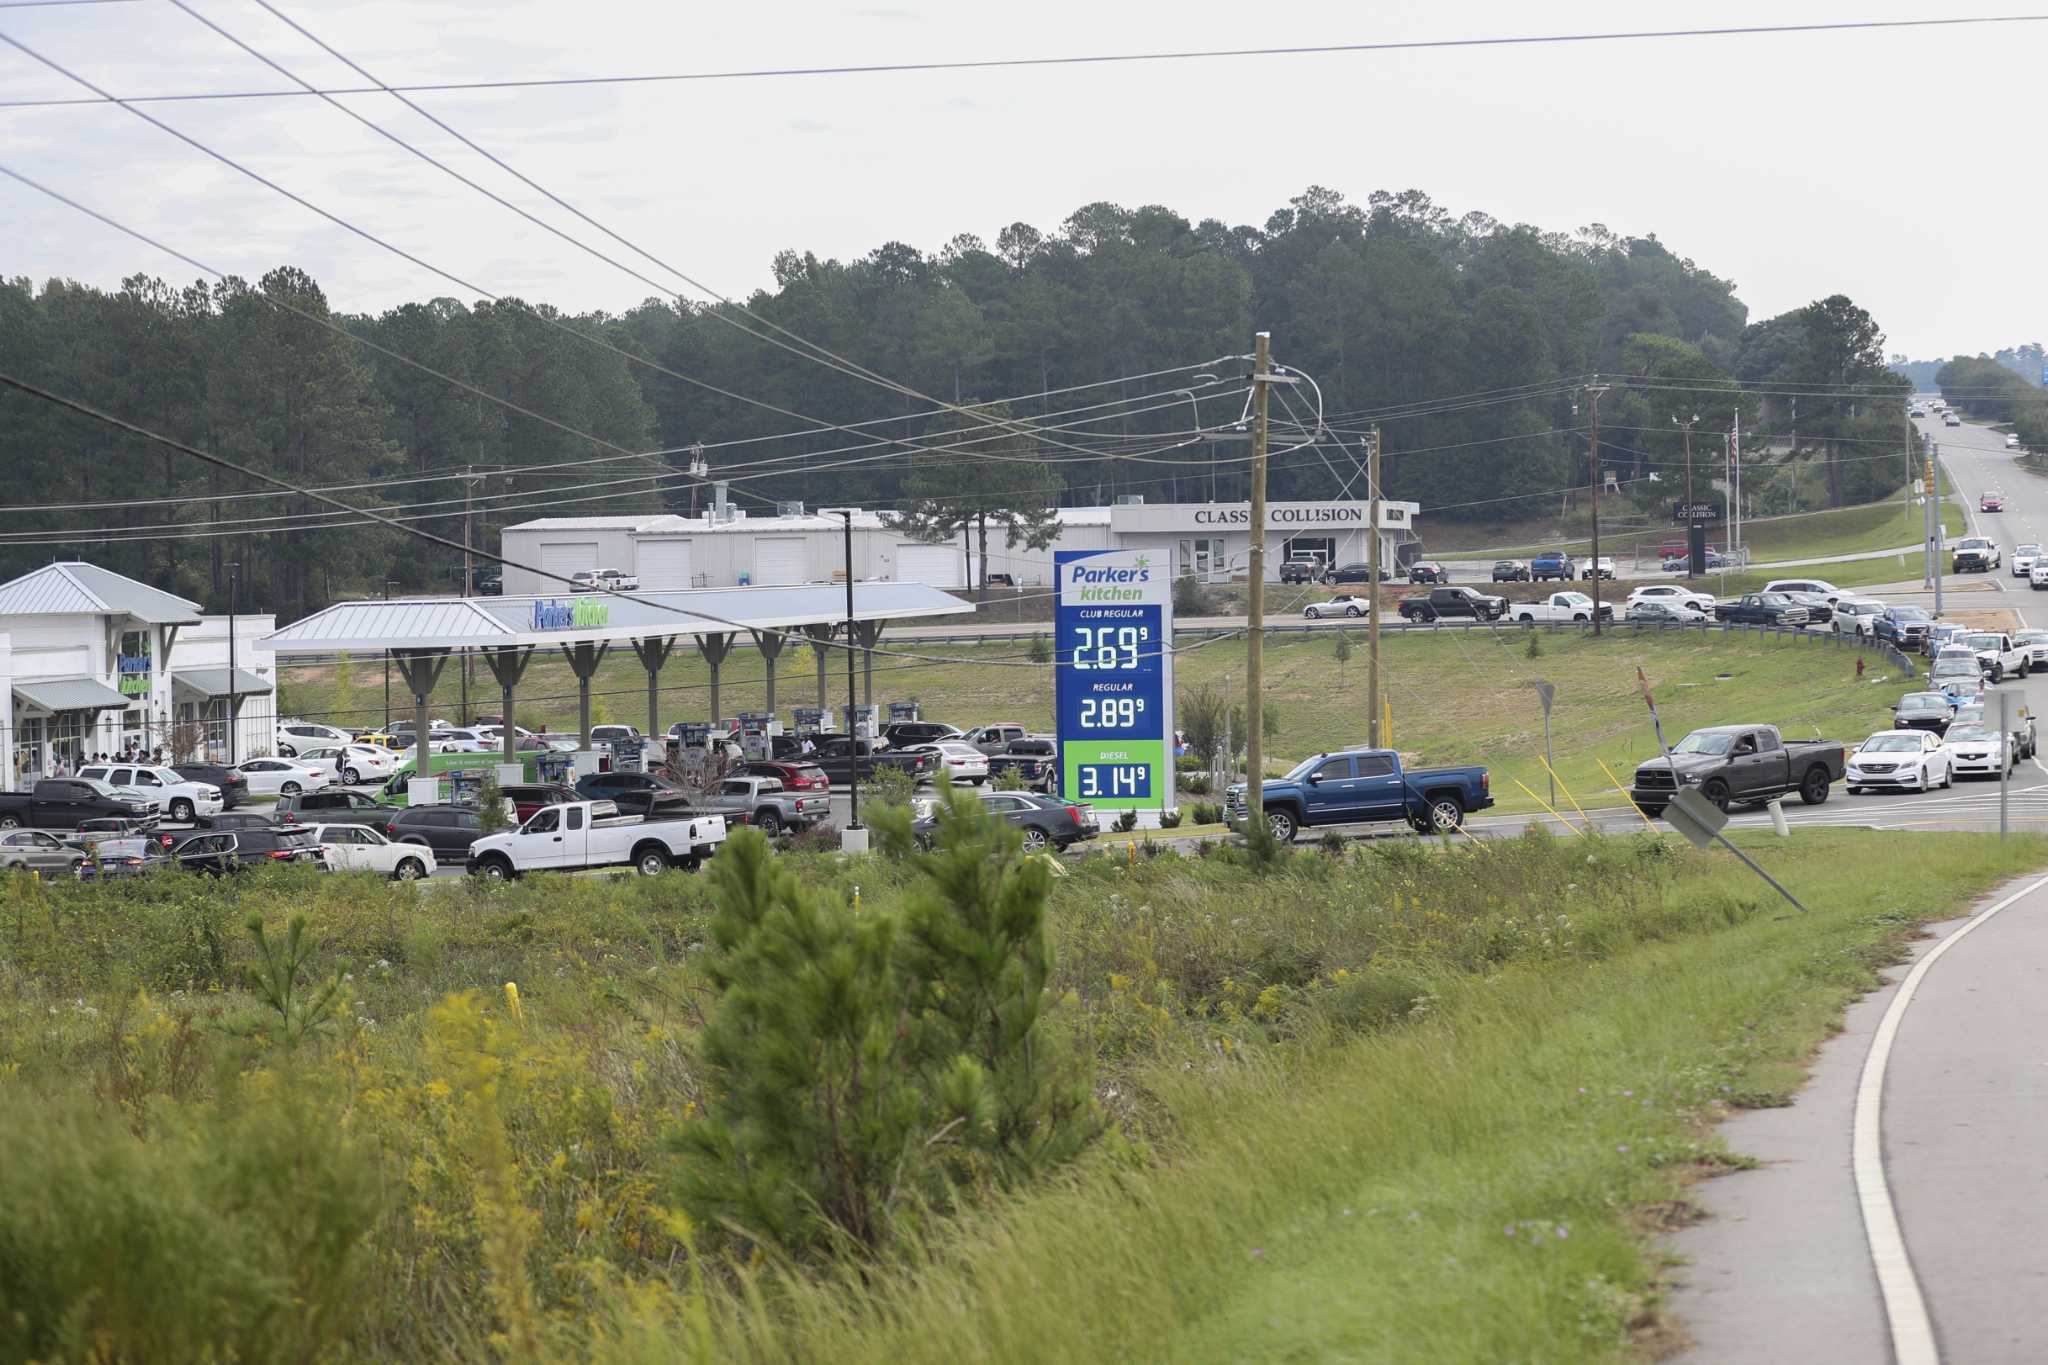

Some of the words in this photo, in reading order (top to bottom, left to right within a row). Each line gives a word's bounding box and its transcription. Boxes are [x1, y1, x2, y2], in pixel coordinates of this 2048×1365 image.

[1194, 510, 1250, 524] CLASS
[1271, 508, 1362, 522] COLLISION
[1080, 586, 1143, 601] kitchen
[1080, 609, 1102, 618] CLUB
[1103, 609, 1144, 618] REGULAR
[1092, 683, 1133, 691] REGULAR
[1100, 752, 1128, 760] DIESEL
